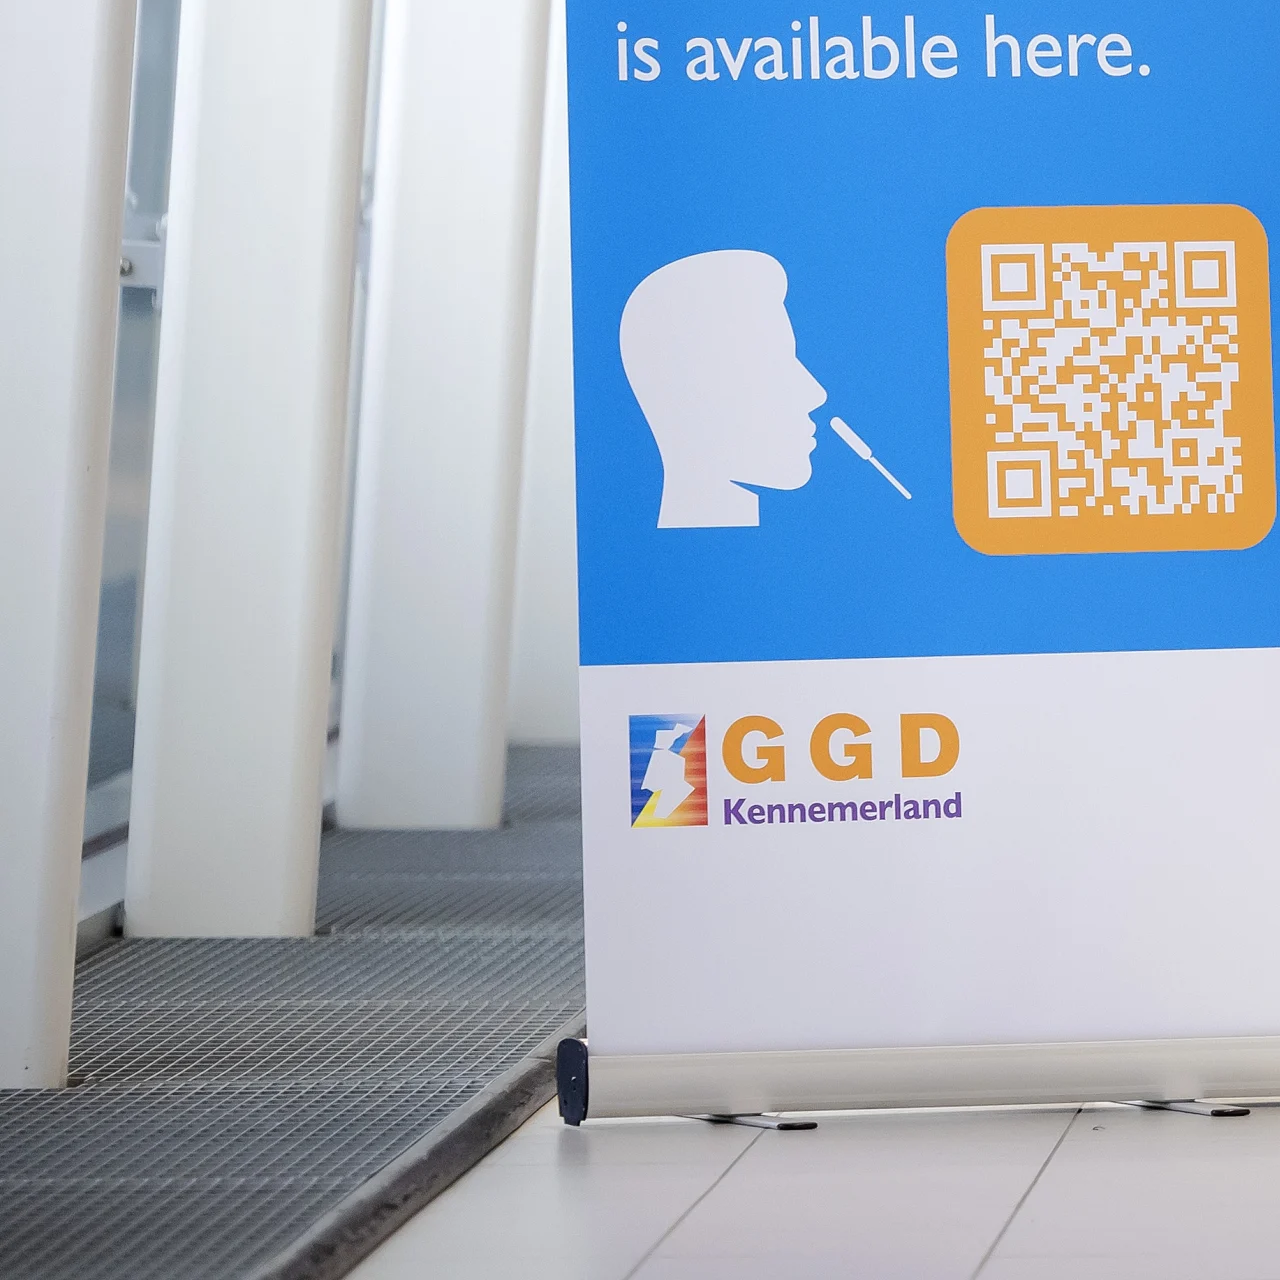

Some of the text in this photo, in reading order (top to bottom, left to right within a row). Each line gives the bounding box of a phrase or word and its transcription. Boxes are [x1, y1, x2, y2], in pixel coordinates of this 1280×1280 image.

[617, 14, 1151, 82] is available here.
[723, 790, 963, 826] Kennemerland
